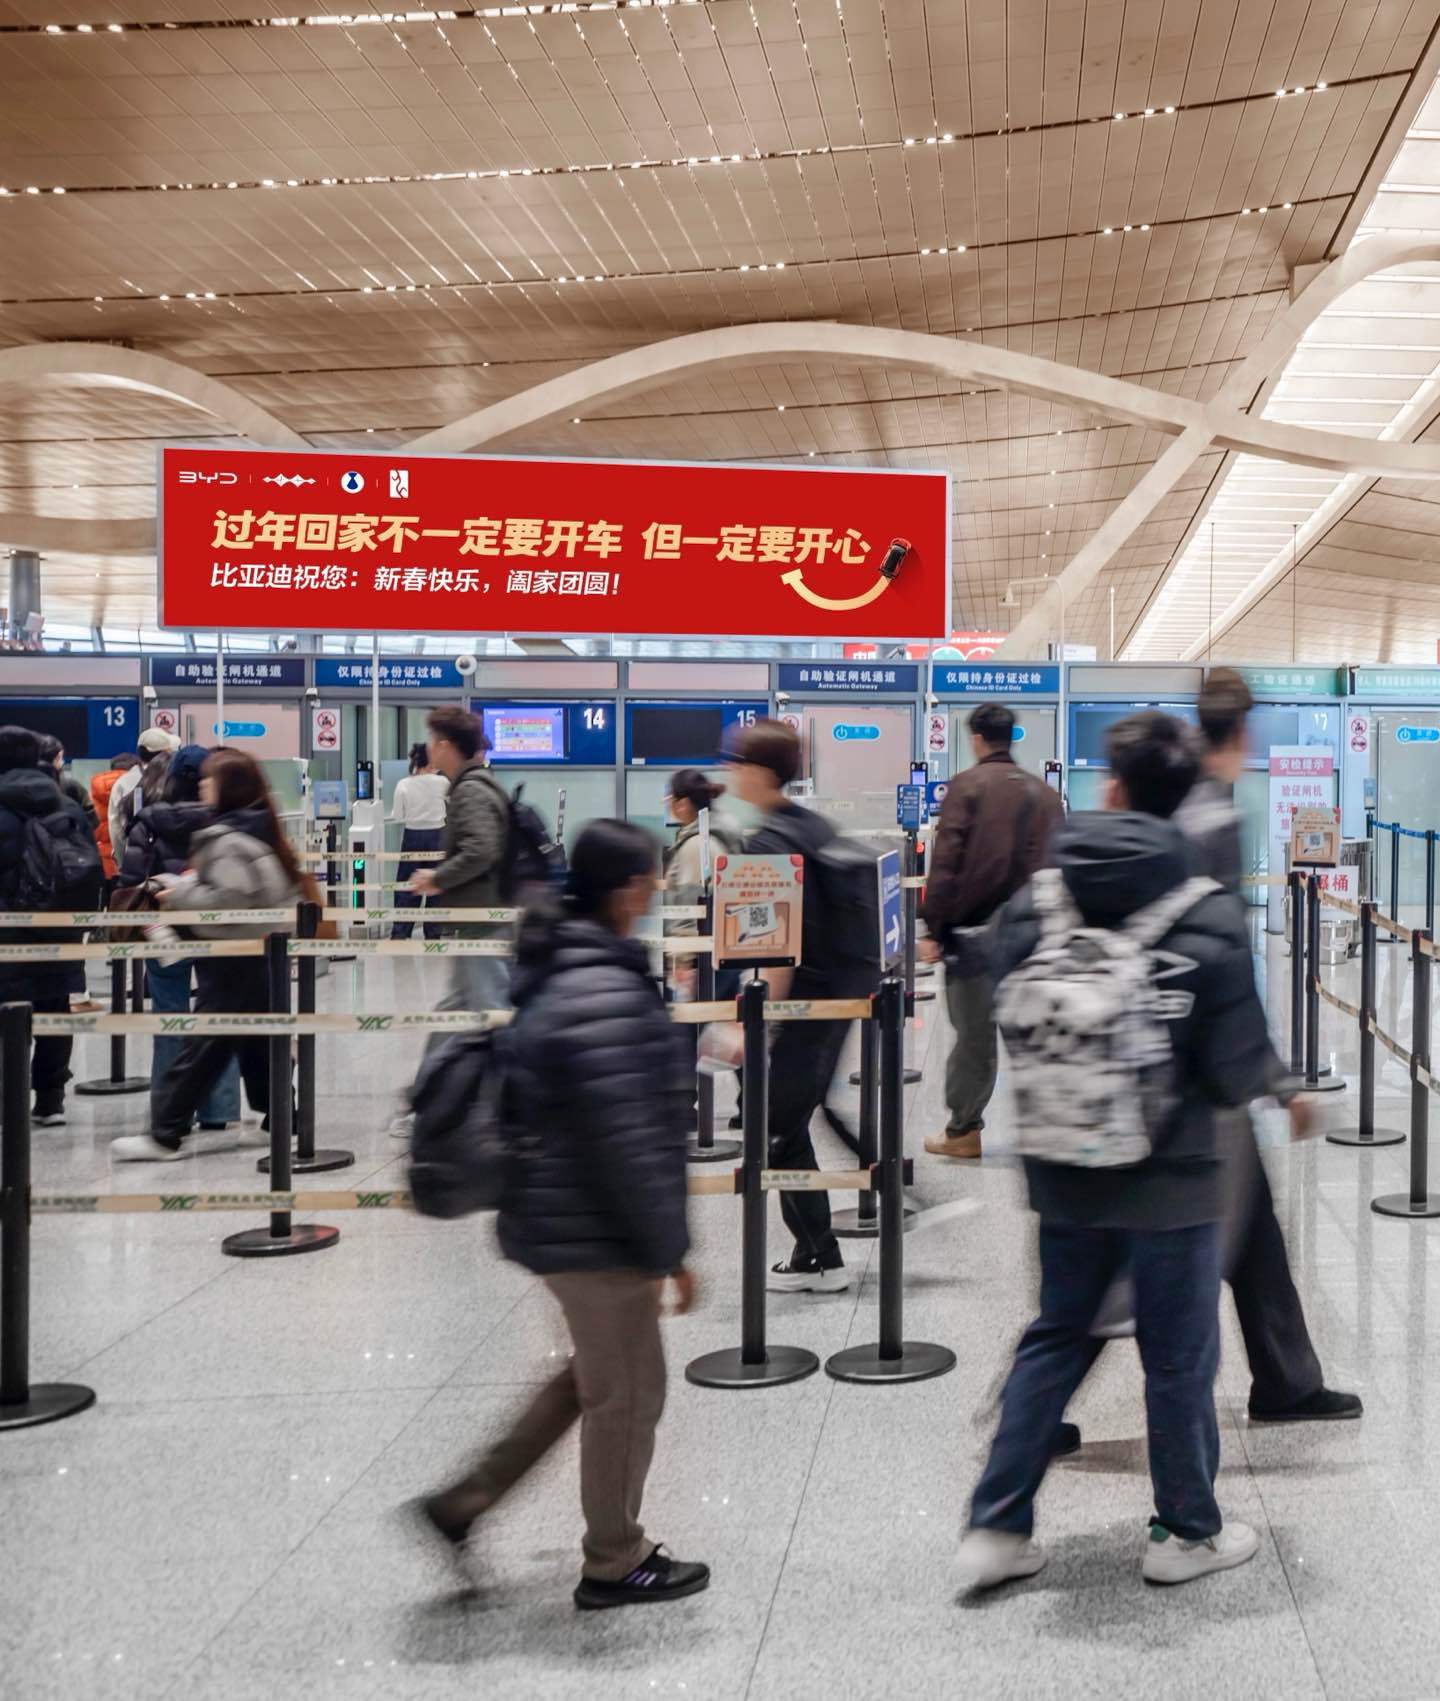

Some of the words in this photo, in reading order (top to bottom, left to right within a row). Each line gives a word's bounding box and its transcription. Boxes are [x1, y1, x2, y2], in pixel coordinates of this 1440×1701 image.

[179, 471, 238, 485] BYD
[211, 510, 623, 560] 过年回家不一定要开车
[641, 522, 871, 565] 但一定要开心
[103, 706, 125, 727] 13
[583, 708, 605, 730] 14
[737, 710, 757, 728] 15
